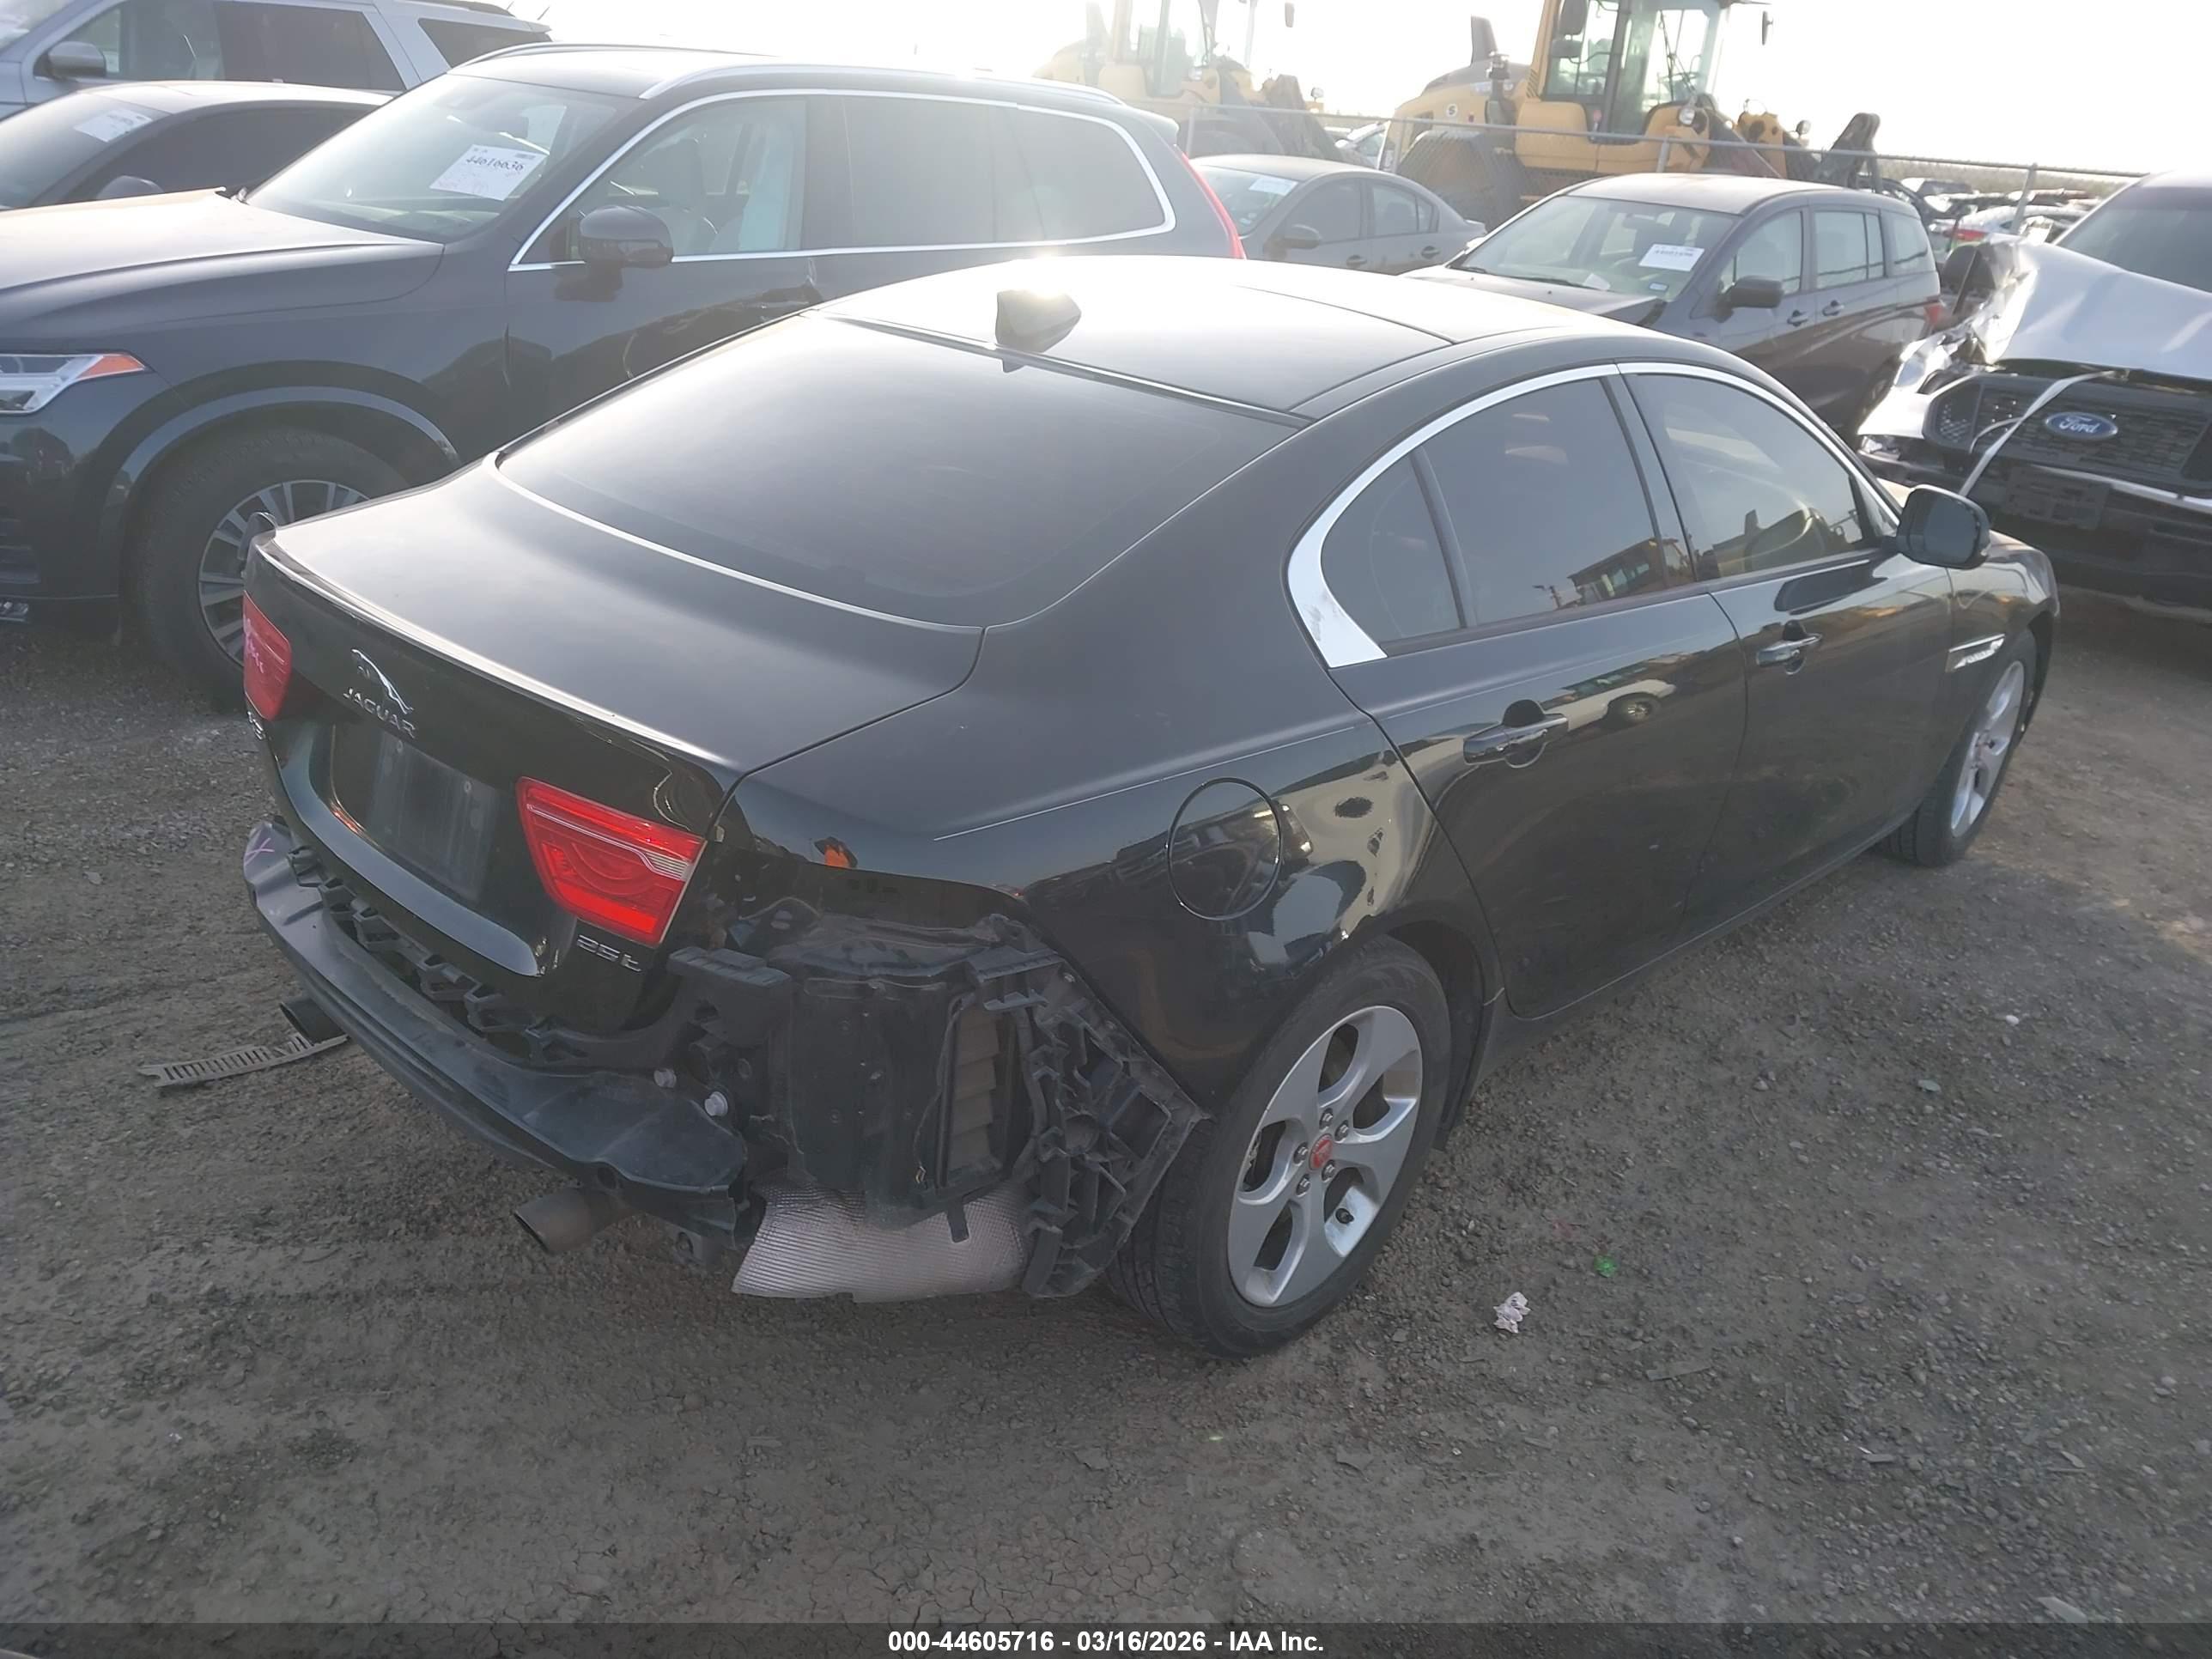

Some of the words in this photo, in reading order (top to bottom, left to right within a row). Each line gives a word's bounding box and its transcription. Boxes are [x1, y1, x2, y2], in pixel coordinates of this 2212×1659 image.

[2059, 416, 2100, 434] Ford
[343, 688, 416, 738] JAGUAR
[577, 934, 641, 972] 25t
